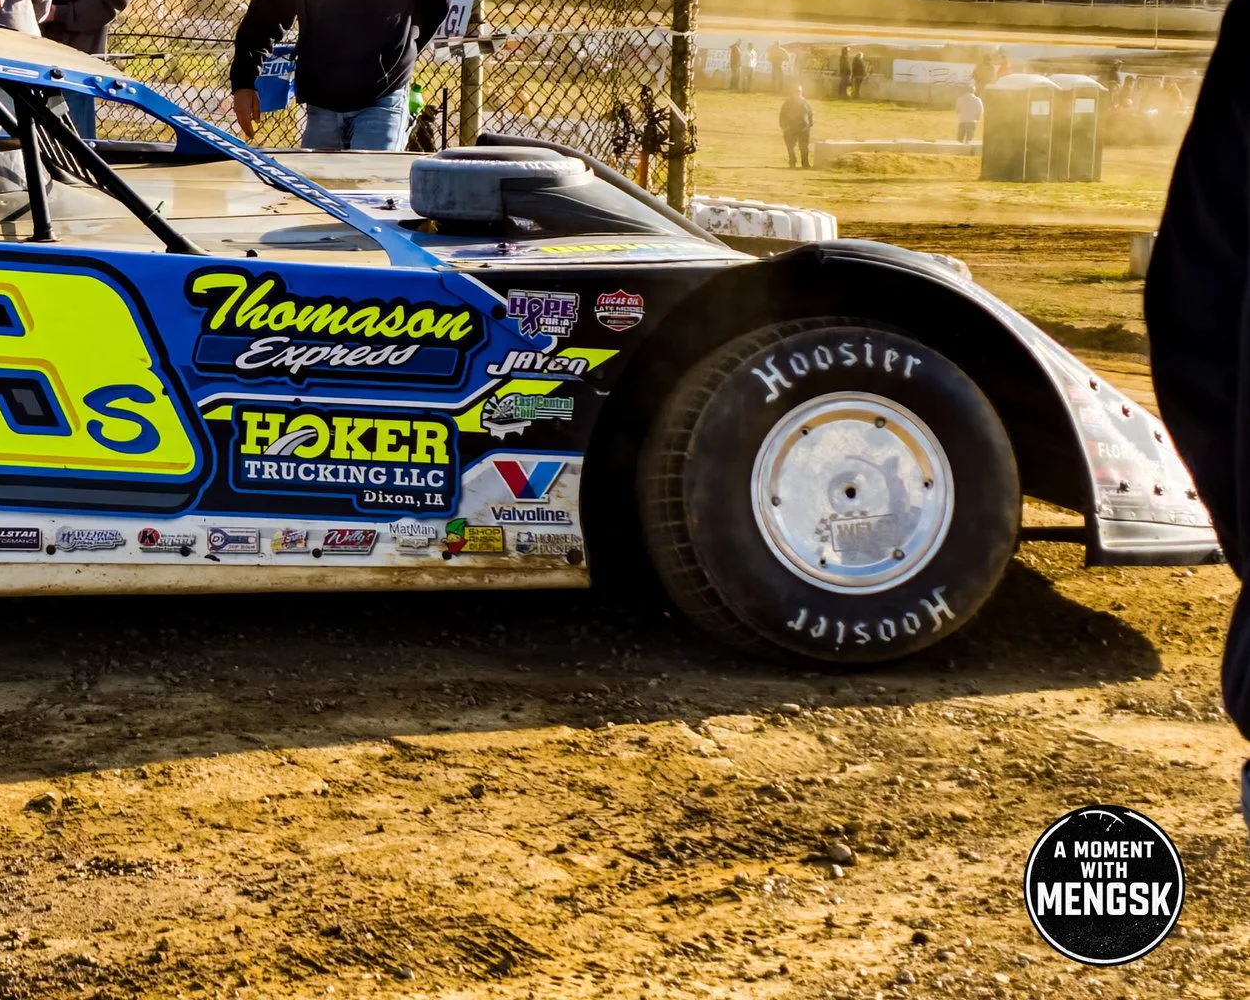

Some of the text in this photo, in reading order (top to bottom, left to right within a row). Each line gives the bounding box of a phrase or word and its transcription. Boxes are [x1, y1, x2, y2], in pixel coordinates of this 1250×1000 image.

[191, 272, 473, 342] Thomason
[509, 296, 576, 319] HOPE
[600, 296, 639, 305] LUCAS OIL
[540, 317, 559, 326] FOR
[540, 326, 567, 334] CURE
[235, 336, 421, 380] Express
[751, 336, 922, 403] Hoosier
[536, 396, 574, 409] Central
[240, 411, 450, 464] HOKER
[244, 461, 444, 488] TRUCKING LLC
[363, 490, 445, 508] Dixon, IA
[491, 506, 566, 521] Valvoline
[326, 530, 374, 545] Willy's
[389, 523, 435, 536] MatMan
[468, 527, 501, 536] SHOP
[786, 584, 956, 651] Hoosier
